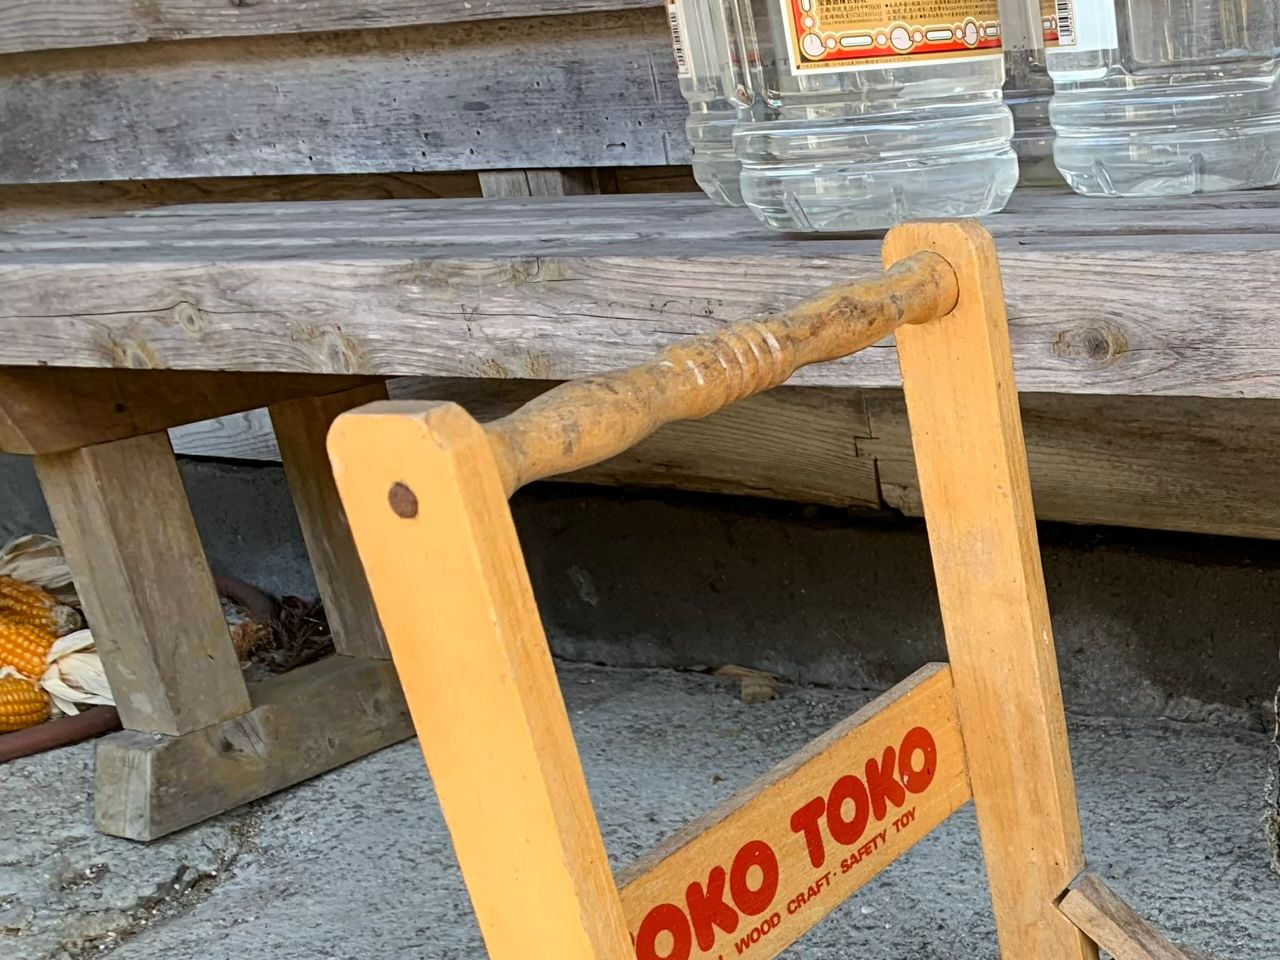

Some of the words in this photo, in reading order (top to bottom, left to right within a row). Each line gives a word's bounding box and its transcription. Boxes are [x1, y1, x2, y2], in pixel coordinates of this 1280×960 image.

[790, 726, 937, 869] TOKO
[734, 912, 782, 956] WOOD
[840, 828, 888, 874] SAFETY
[892, 806, 917, 834] TOY
